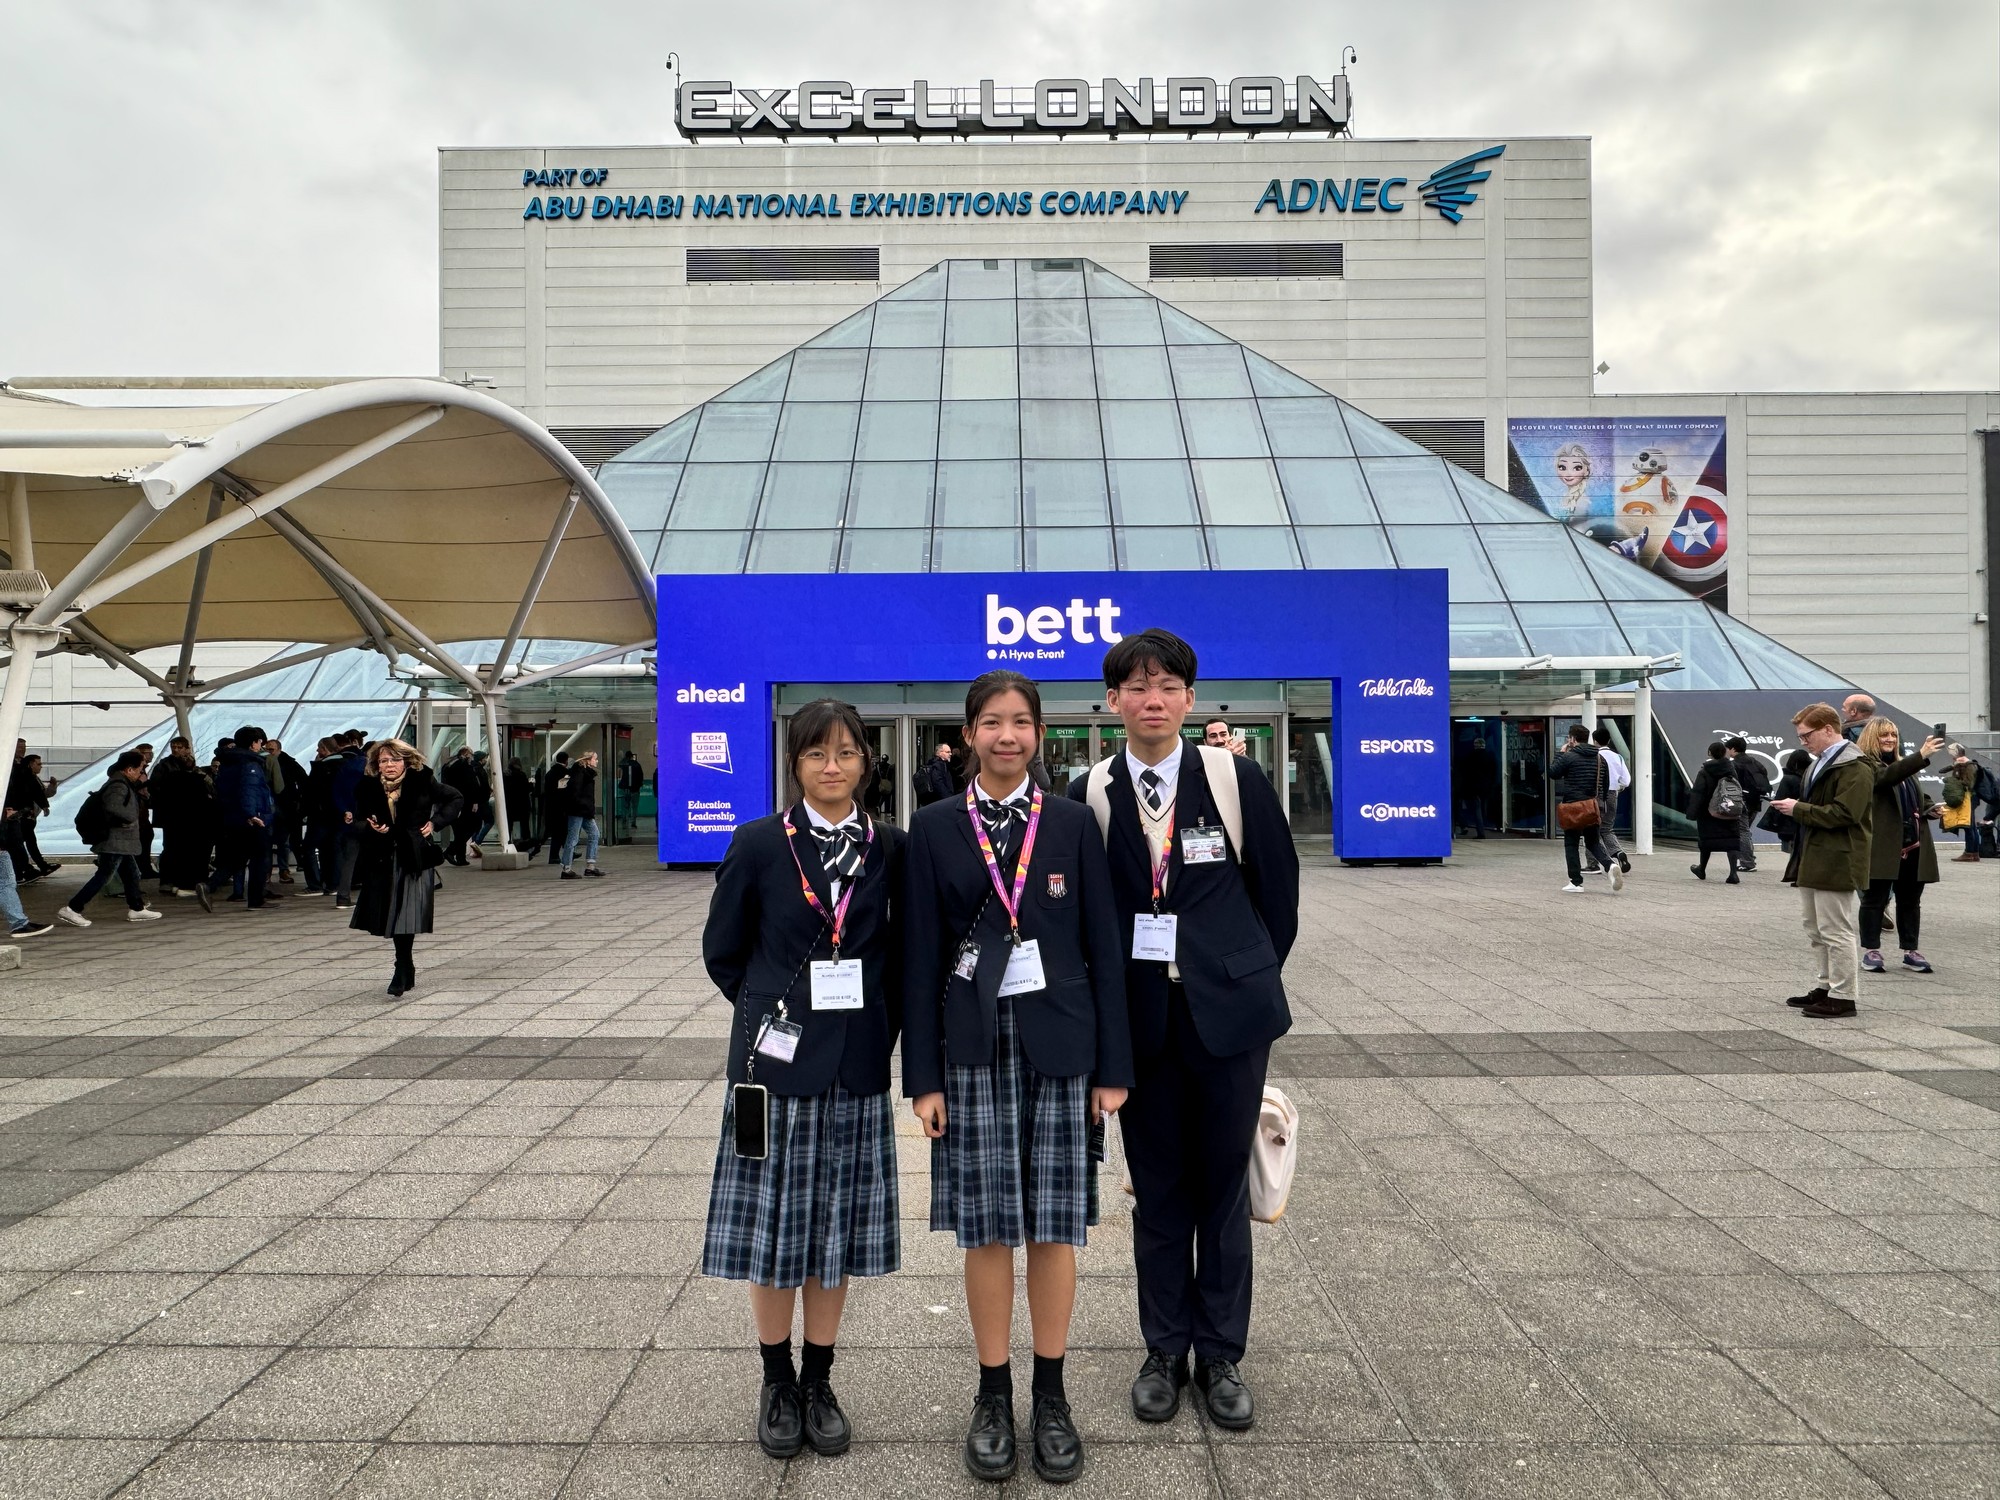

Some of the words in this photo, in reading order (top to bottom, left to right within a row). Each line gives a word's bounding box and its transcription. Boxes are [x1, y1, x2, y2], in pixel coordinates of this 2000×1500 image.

[980, 75, 1349, 130] LONDON
[523, 168, 577, 187] PART
[579, 168, 608, 187] OF
[523, 196, 585, 220] ABU
[591, 195, 684, 219] DHABI
[692, 193, 842, 219] NATIONAL
[850, 191, 1032, 217] EXHIBITIONS
[1039, 189, 1190, 215] COMPANY
[1254, 178, 1408, 213] ADNEC
[986, 594, 1123, 645] bett
[999, 650, 1008, 659] A
[1009, 650, 1035, 662] Hyve
[1037, 649, 1065, 659] Event
[676, 683, 745, 703] ahead
[1360, 740, 1434, 753] ESPORTS
[688, 801, 731, 809] Education
[1360, 803, 1436, 821] Connect
[688, 812, 736, 822] Leadership
